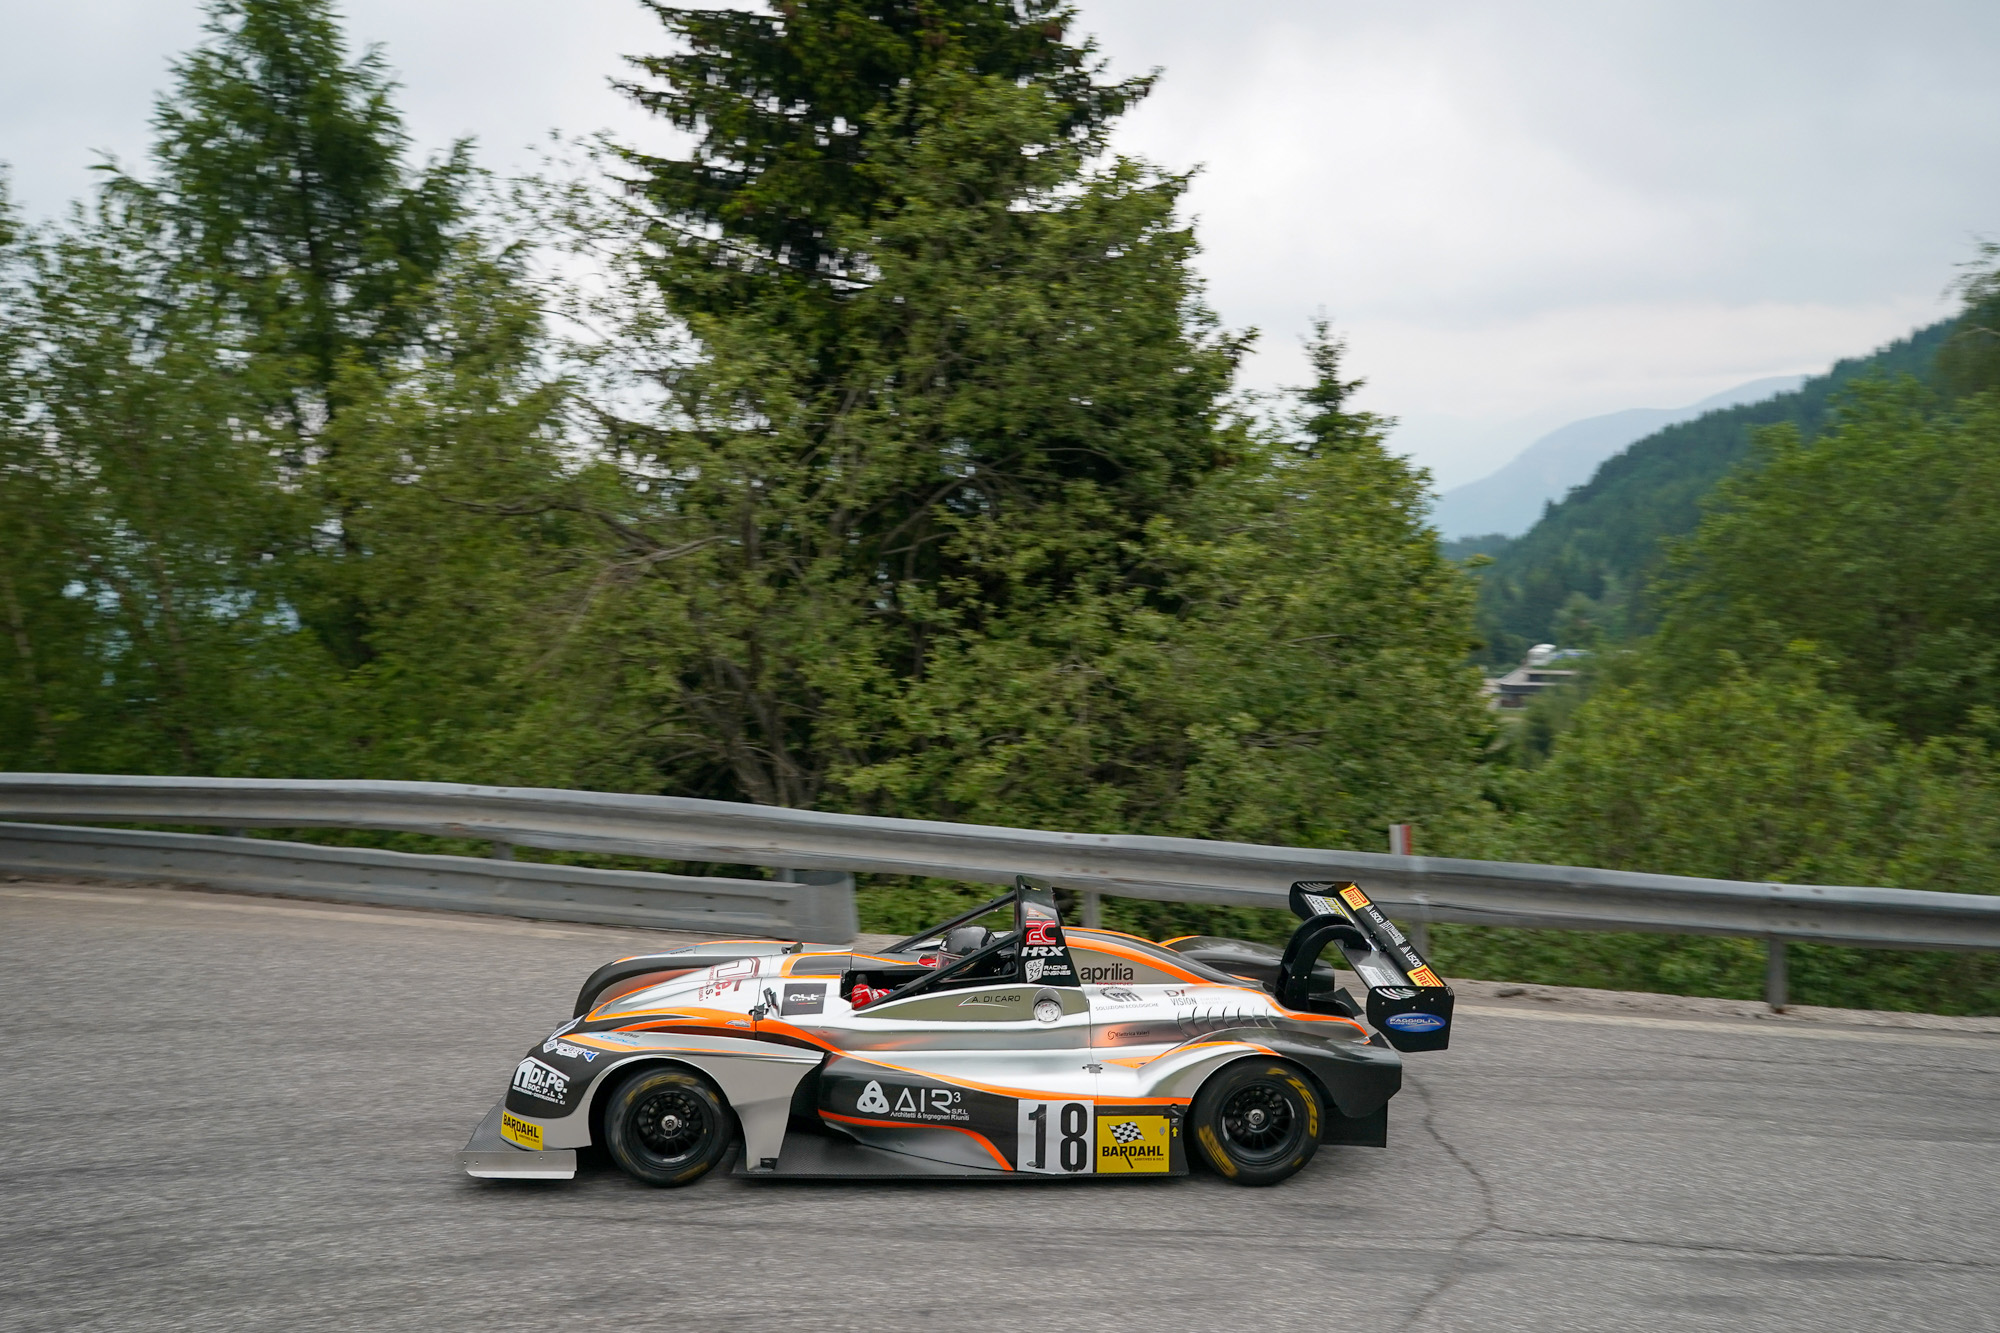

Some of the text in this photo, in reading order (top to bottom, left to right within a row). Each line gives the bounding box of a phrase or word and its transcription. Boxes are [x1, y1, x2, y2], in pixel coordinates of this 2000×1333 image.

[1344, 887, 1368, 907] PIRELLI
[1021, 946, 1066, 957] HRX
[1026, 960, 1042, 970] GAS
[1028, 967, 1041, 980] 39
[1080, 963, 1134, 985] aprilia
[1170, 997, 1198, 1006] VISION
[529, 1067, 568, 1094] Di.Pe.
[890, 1111, 916, 1119] Architetti
[503, 1114, 540, 1138] BARDAHL
[1028, 1102, 1088, 1172] 18
[1102, 1145, 1164, 1157] BARDAHL
